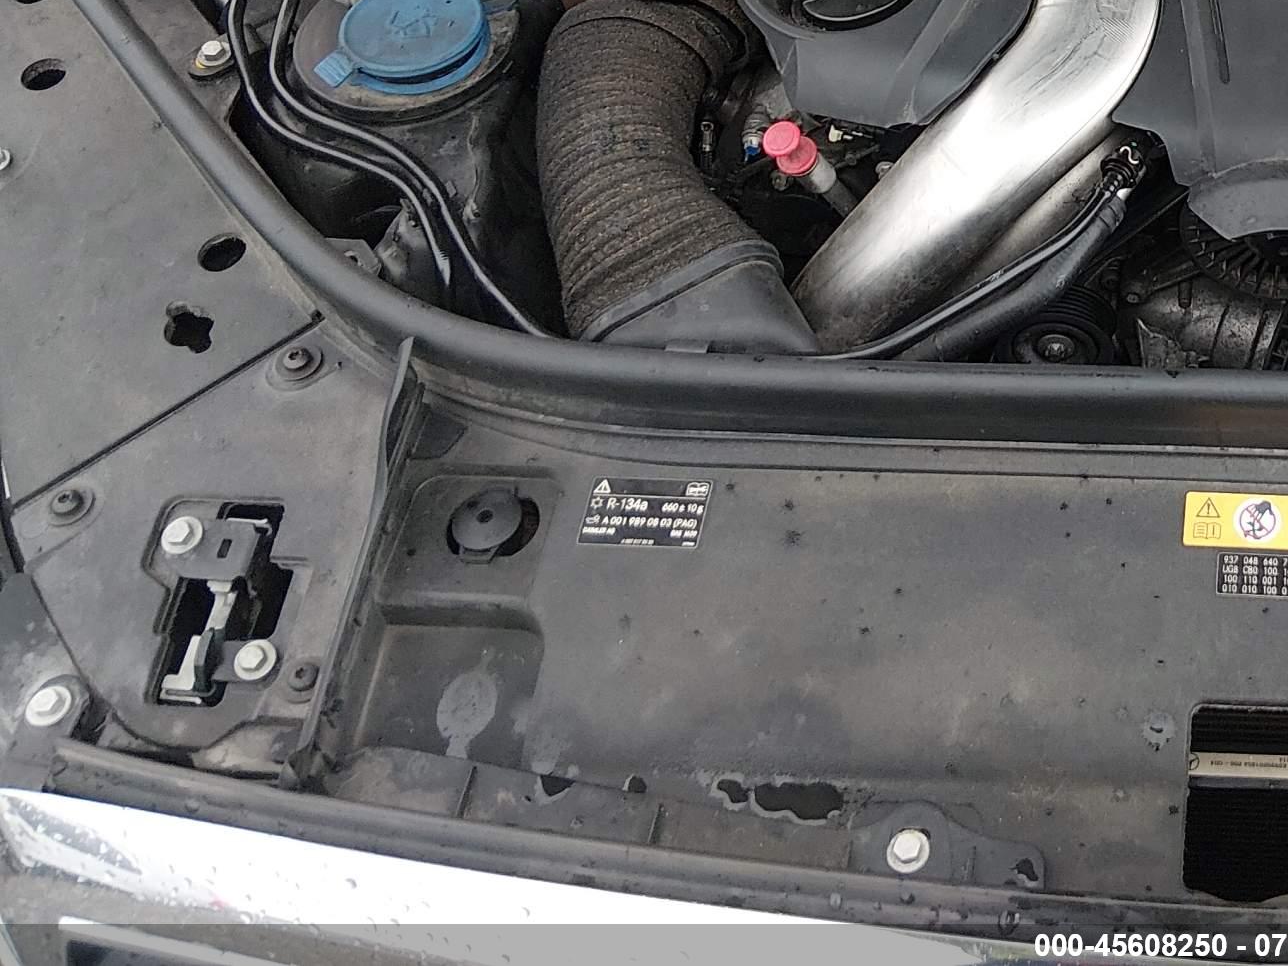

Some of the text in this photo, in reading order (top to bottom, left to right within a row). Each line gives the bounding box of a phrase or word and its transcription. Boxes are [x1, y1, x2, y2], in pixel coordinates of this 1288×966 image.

[606, 497, 649, 511] R-134a
[661, 502, 679, 513] 660
[601, 516, 609, 525] A
[609, 516, 627, 526] 001
[628, 517, 647, 527] 989
[672, 518, 698, 529] (PAG)
[1224, 555, 1239, 564] 937
[1263, 557, 1278, 566] 640
[1264, 567, 1278, 575] 100
[1223, 574, 1238, 583] 100
[1244, 575, 1258, 584] 110
[1262, 576, 1277, 585] 001
[1222, 584, 1238, 593] 010
[1241, 584, 1257, 594] 010
[1263, 586, 1277, 594] 100
